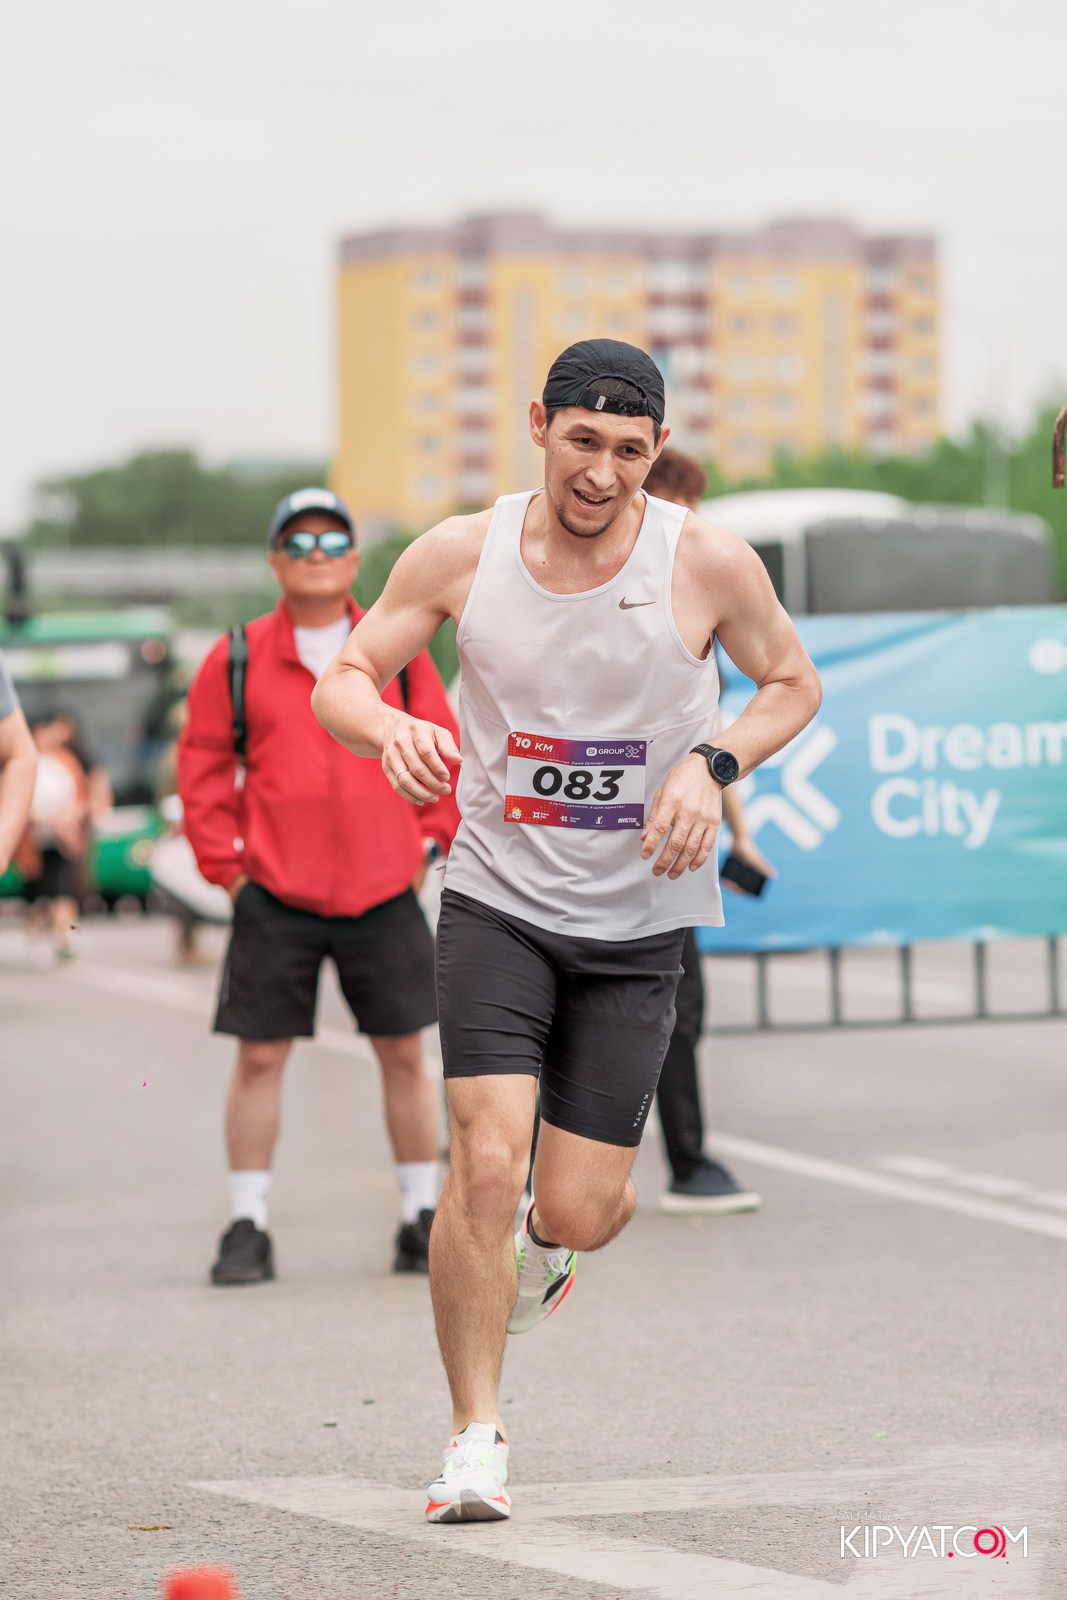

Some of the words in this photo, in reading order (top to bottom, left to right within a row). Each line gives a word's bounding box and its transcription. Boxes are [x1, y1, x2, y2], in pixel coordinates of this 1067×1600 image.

[515, 736, 531, 749] 10
[534, 742, 554, 753] KM
[868, 713, 1067, 773] Dream
[532, 765, 625, 802] 083
[871, 776, 1002, 850] City
